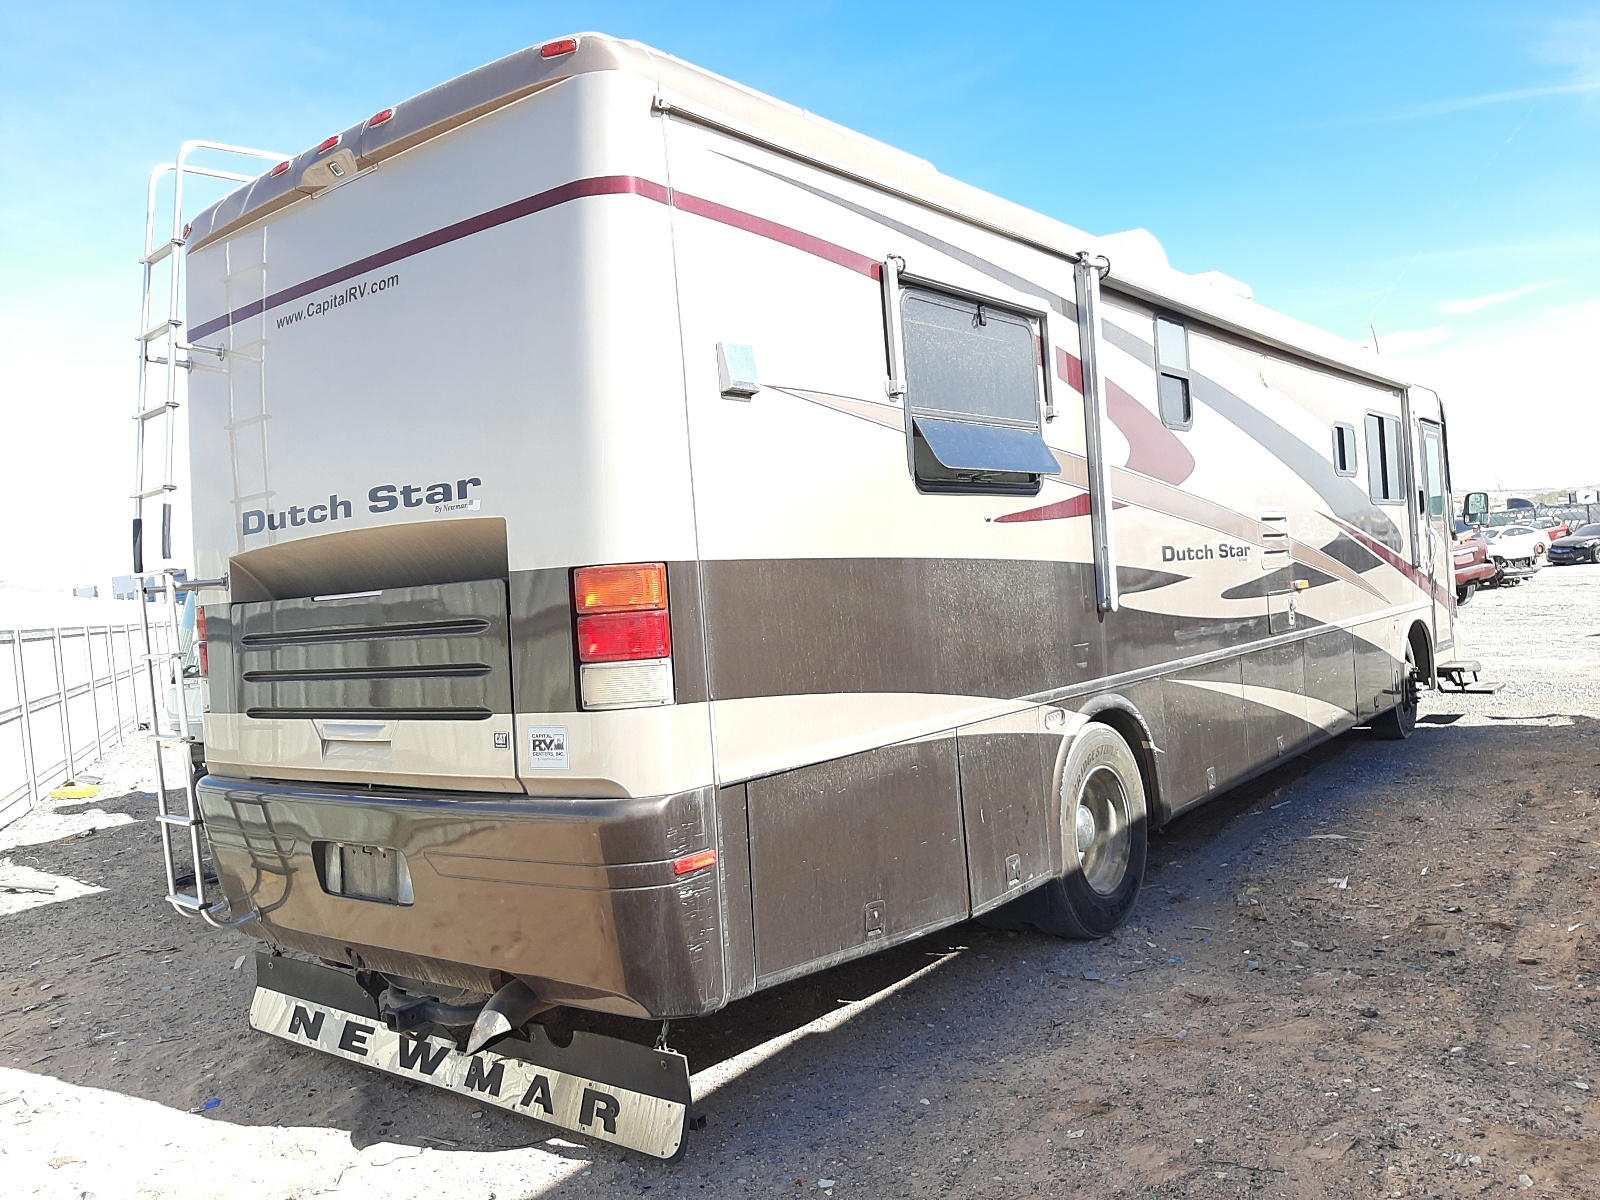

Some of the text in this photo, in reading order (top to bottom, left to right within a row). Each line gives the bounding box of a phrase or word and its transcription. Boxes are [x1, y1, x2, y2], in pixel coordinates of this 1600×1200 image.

[276, 273, 400, 329] www.CapitalRV.com
[241, 476, 482, 536] Dutch Star
[1161, 543, 1251, 562] Dutch Star
[288, 1004, 620, 1134] NEWMAR
